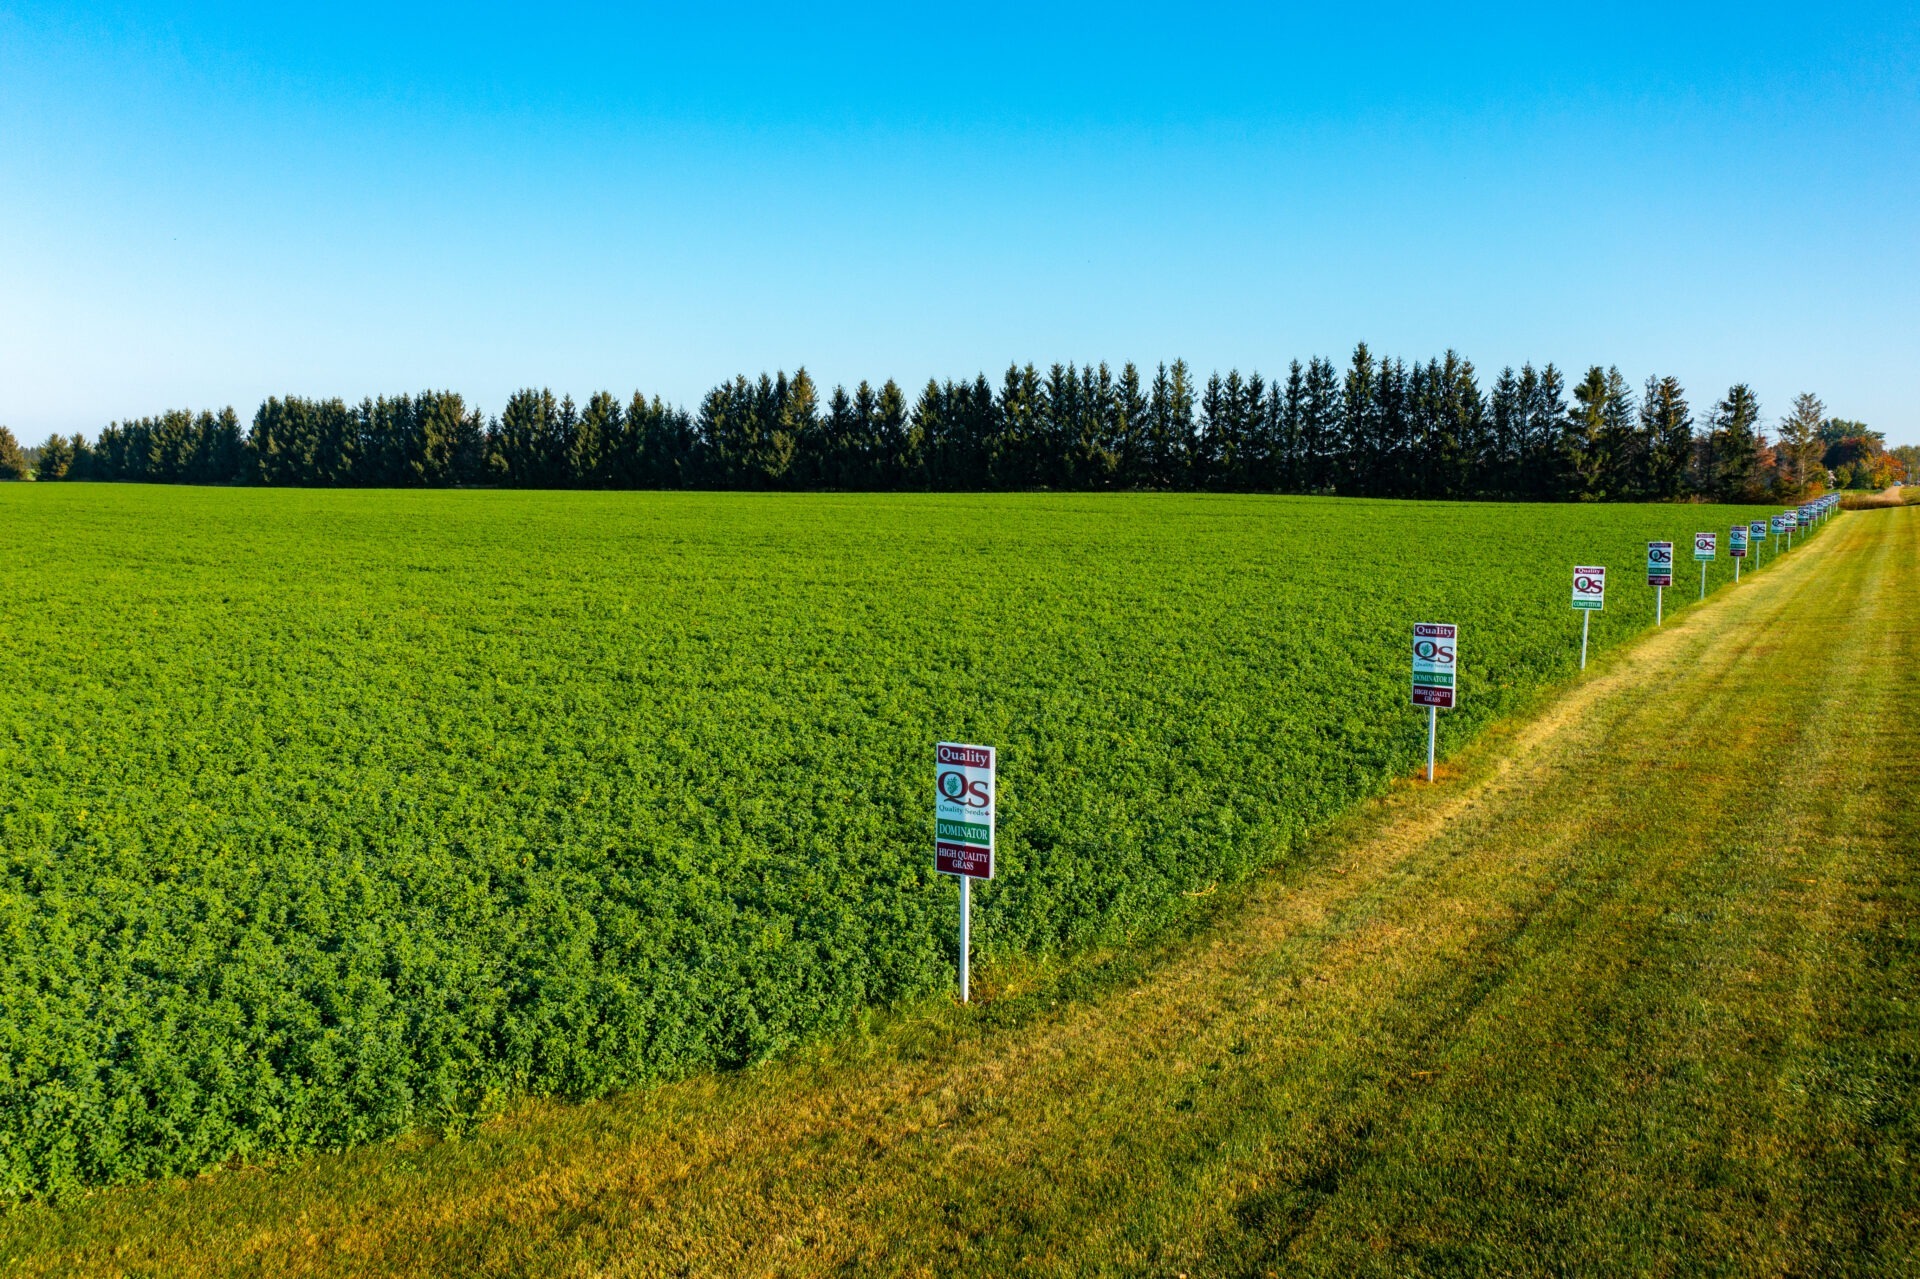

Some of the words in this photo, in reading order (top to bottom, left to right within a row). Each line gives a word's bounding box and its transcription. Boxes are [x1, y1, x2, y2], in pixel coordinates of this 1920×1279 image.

[1696, 539, 1715, 550] QS
[1649, 549, 1671, 563] QS
[1574, 576, 1603, 594] QS
[1416, 625, 1453, 637] Quality
[1414, 641, 1454, 664] QS
[1414, 674, 1447, 683] DOMINATOR
[1415, 688, 1428, 696] HIGH
[1429, 690, 1451, 698] QUALITY
[940, 747, 988, 766] Quality
[938, 771, 990, 808] QS
[939, 805, 963, 815] Quality
[940, 823, 988, 840] DOMINATOR
[938, 847, 957, 858] HIGH
[957, 850, 988, 863] QUALITY
[952, 859, 974, 870] GRASS
